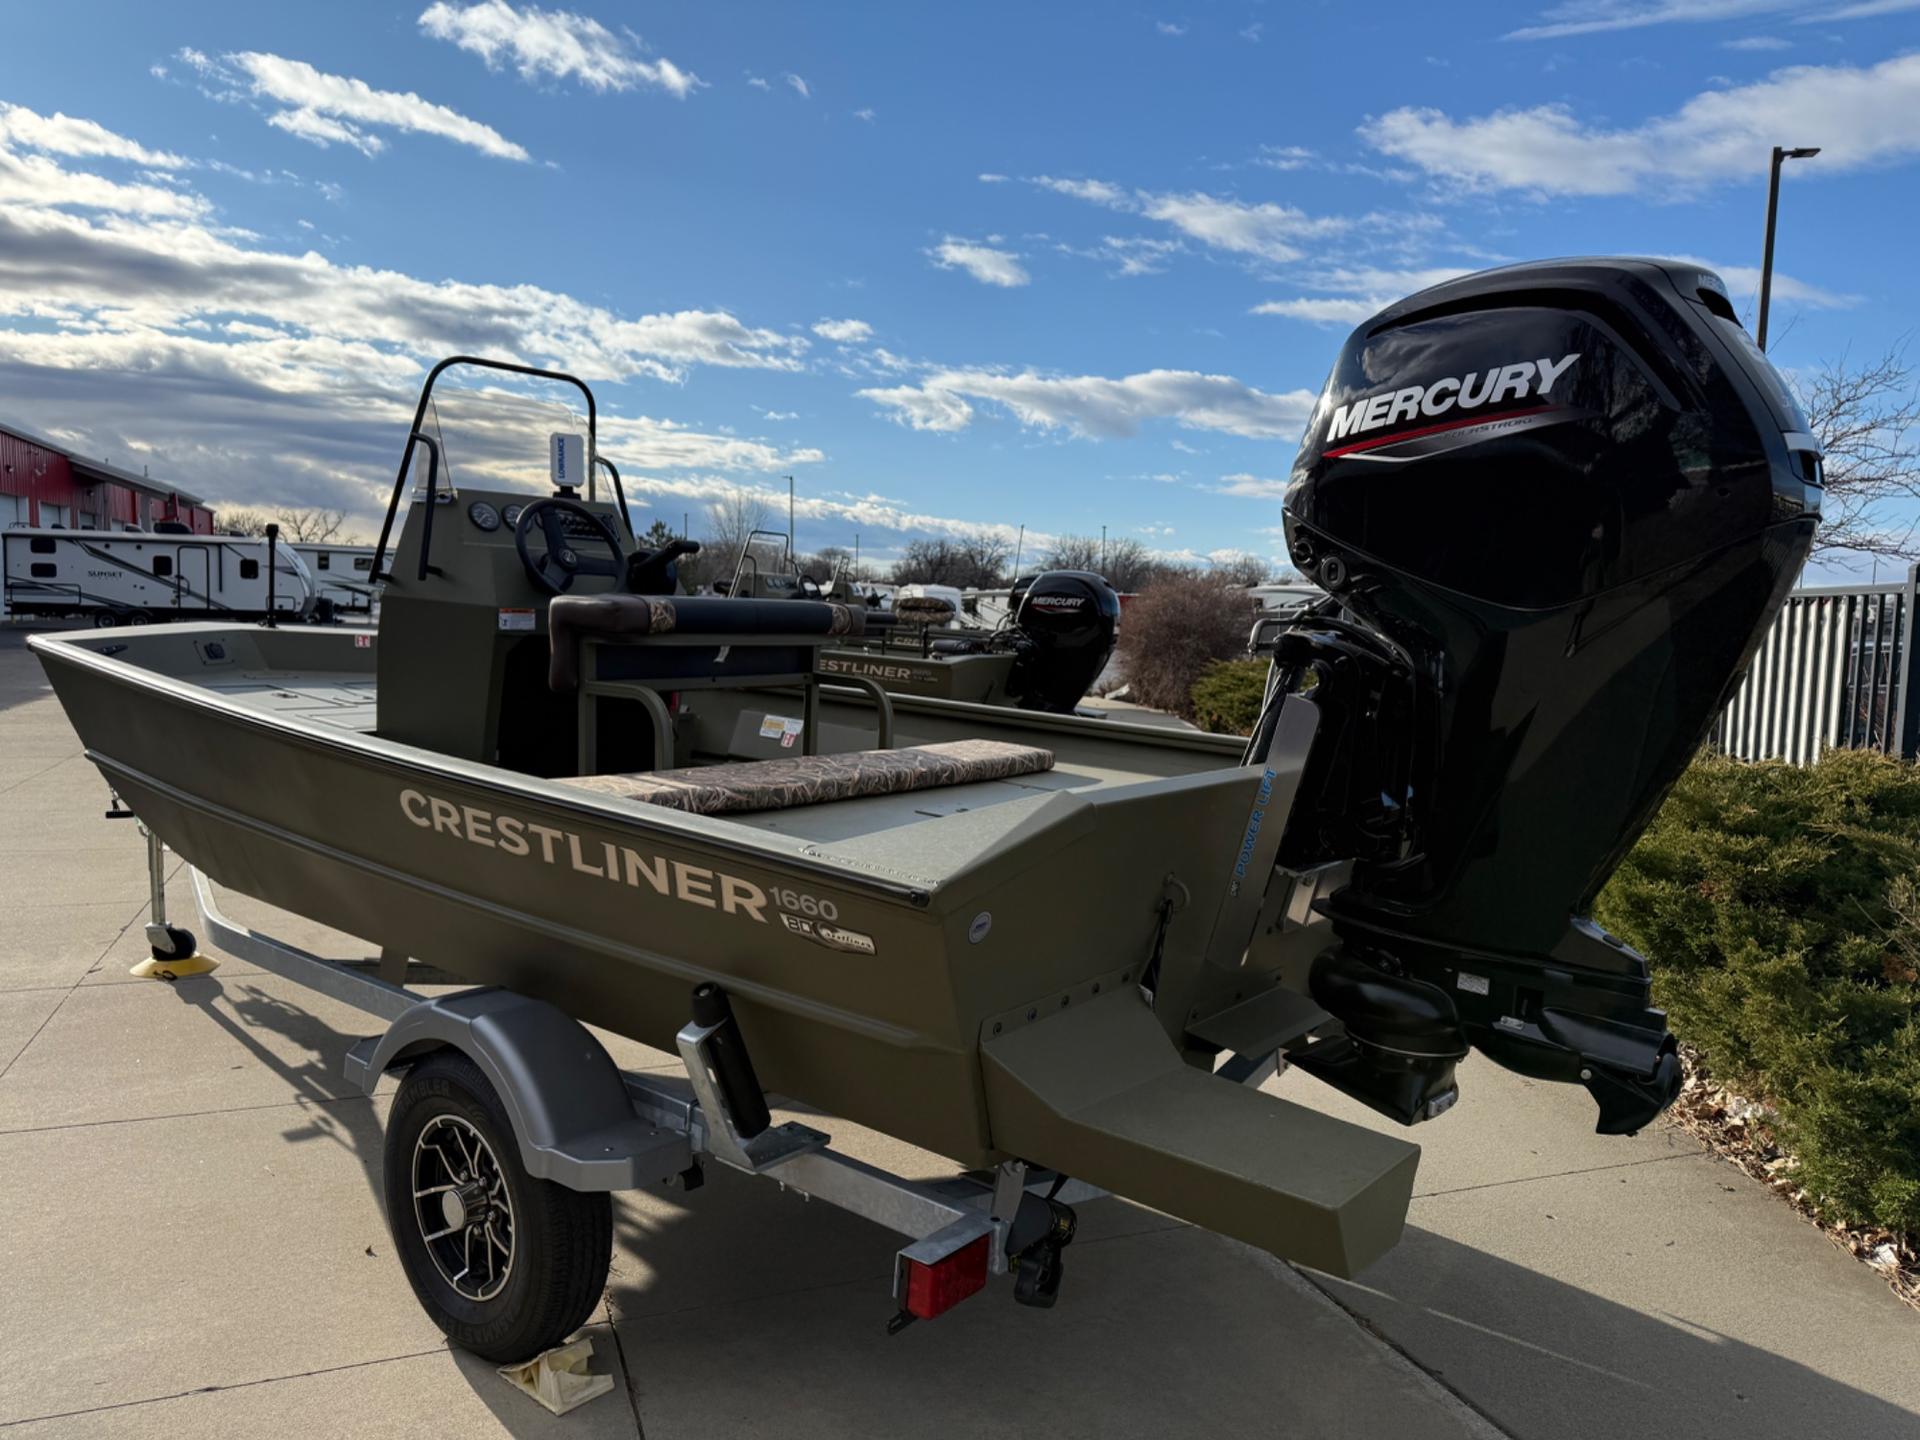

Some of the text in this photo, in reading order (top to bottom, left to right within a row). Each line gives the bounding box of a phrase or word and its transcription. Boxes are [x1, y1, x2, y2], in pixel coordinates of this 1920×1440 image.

[1326, 353, 1581, 443] MERCURY
[87, 570, 124, 579] SUNSET
[1031, 596, 1085, 607] MERCURY
[819, 659, 911, 679] ESTLINER
[1234, 808, 1264, 878] POWER
[1257, 766, 1278, 805] LIFT
[400, 788, 839, 924] CRESTLINER 1660
